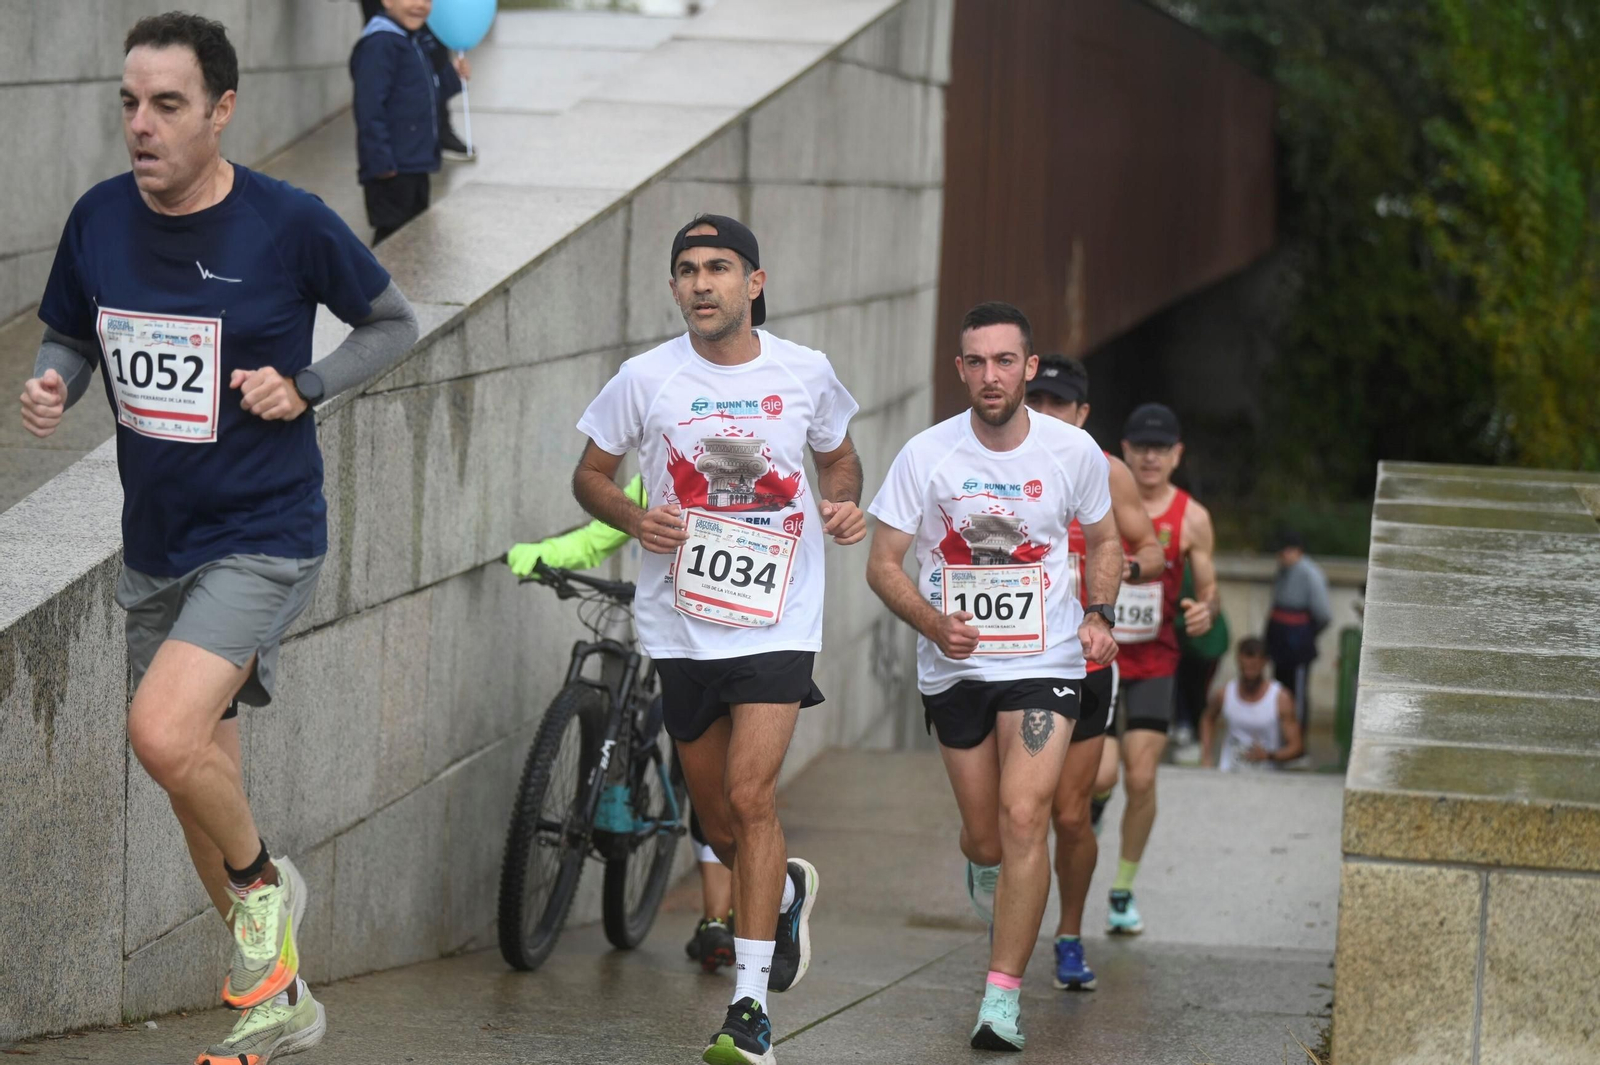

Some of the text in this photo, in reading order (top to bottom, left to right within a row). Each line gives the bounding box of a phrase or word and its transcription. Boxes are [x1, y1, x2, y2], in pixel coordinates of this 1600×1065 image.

[112, 348, 204, 394] 1052
[762, 398, 782, 412] aje
[1024, 483, 1041, 495] aje
[687, 544, 777, 594] 1034
[954, 592, 1034, 620] 1067
